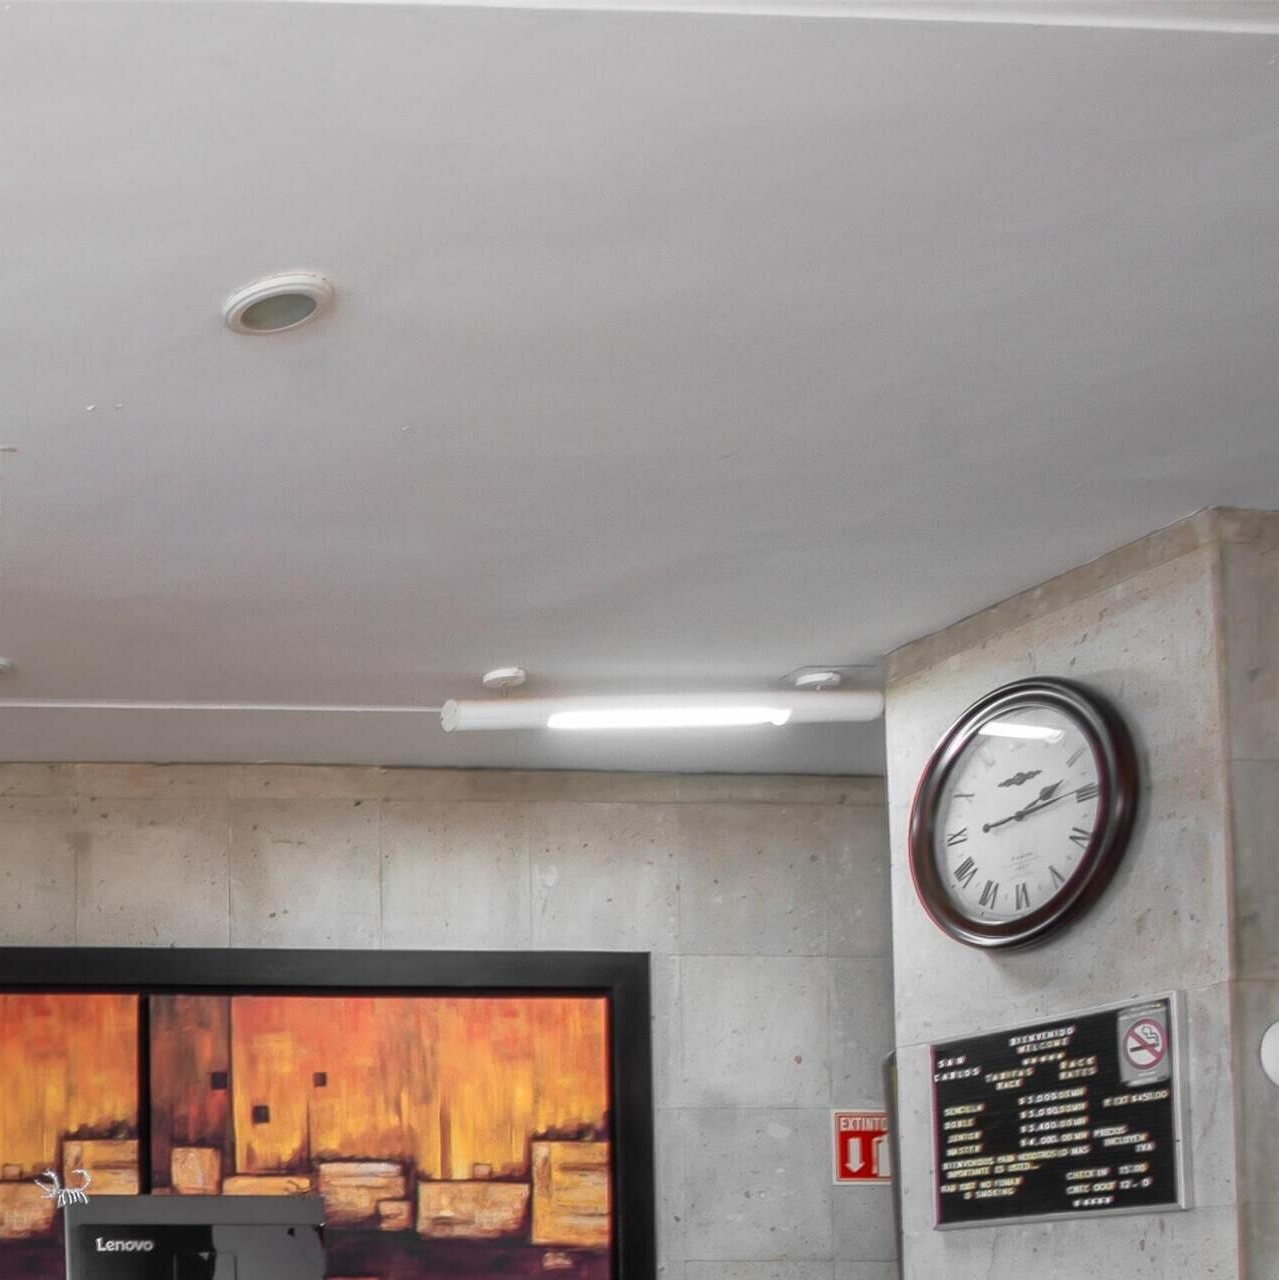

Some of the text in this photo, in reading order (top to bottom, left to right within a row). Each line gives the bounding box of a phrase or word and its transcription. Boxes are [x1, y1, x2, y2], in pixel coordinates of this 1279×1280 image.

[938, 1056, 966, 1068] SAN
[934, 1066, 981, 1082] CARLOS
[95, 1237, 154, 1251] Lenovo
